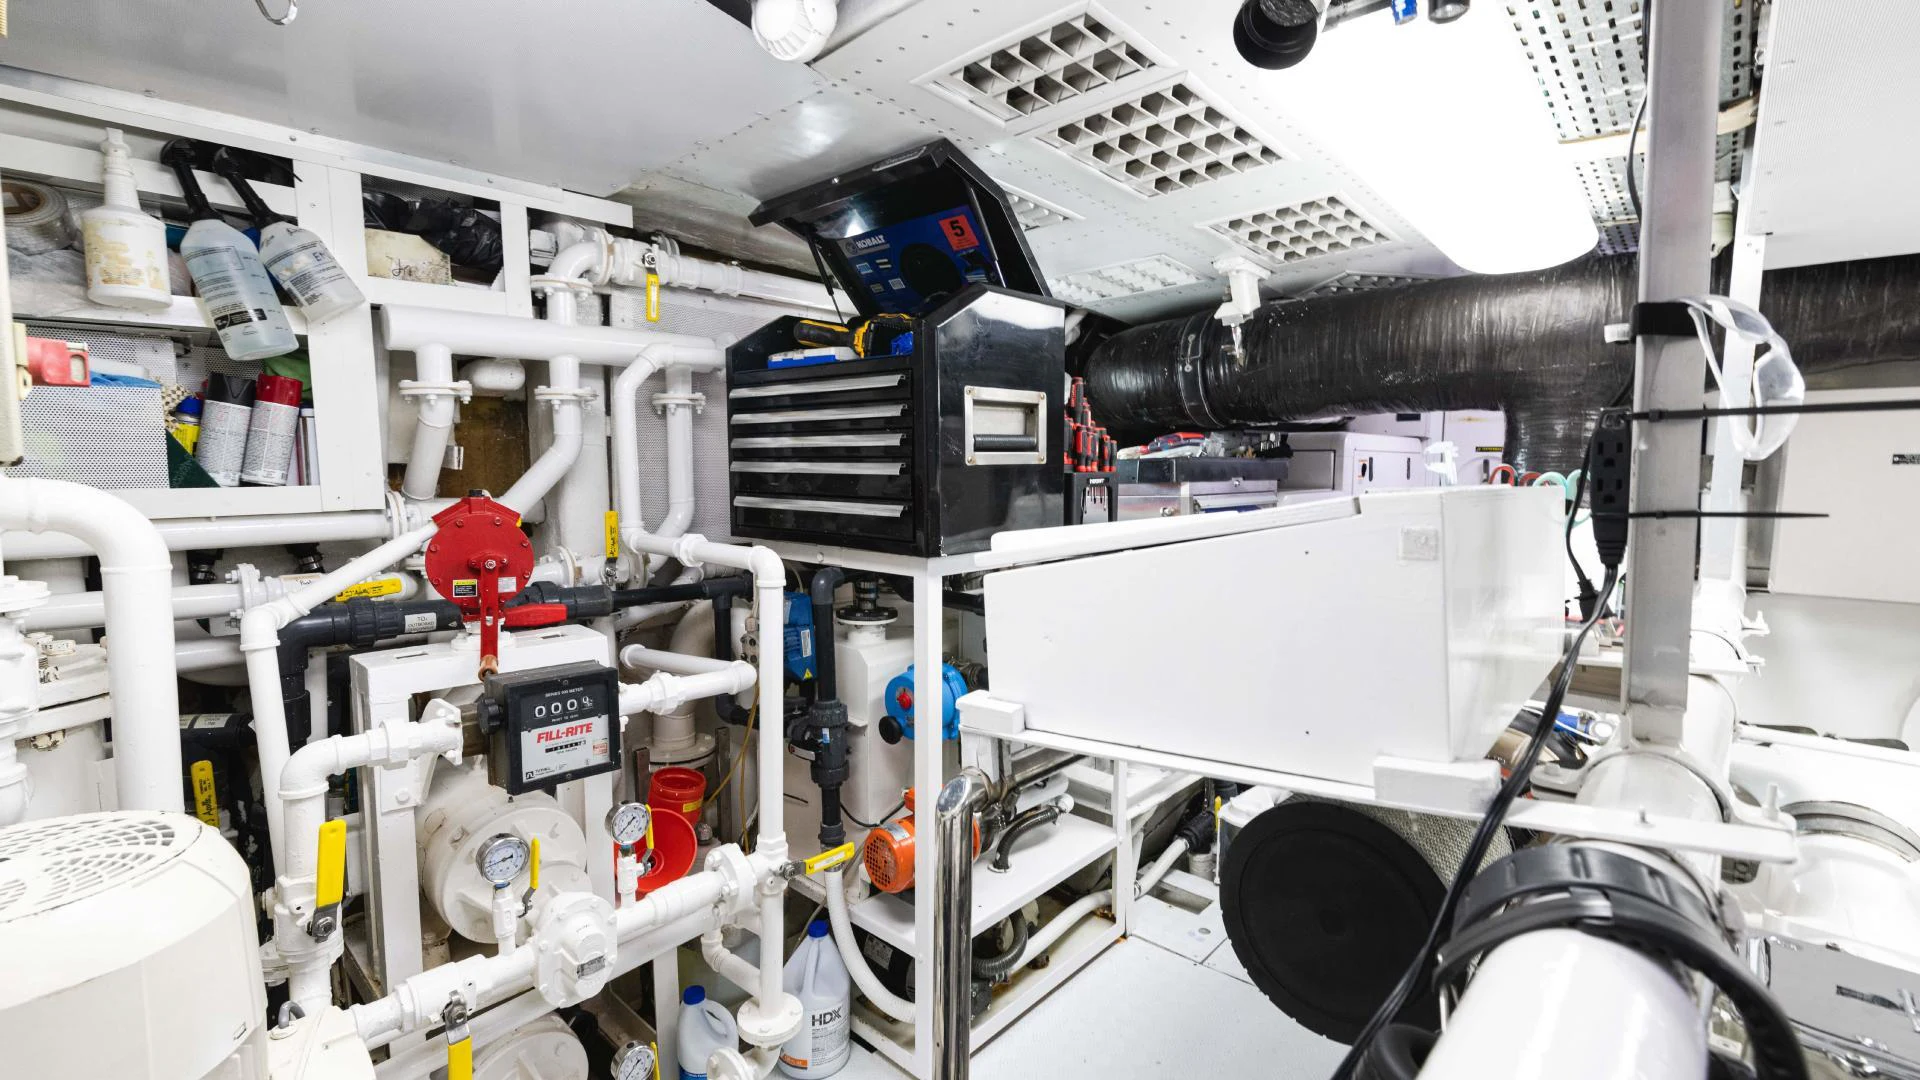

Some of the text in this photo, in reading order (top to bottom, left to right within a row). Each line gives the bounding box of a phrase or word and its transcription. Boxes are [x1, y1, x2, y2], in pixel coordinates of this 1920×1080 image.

[949, 220, 965, 237] 5
[856, 235, 885, 249] KOBALT
[537, 722, 592, 744] FILL-RITE
[812, 1007, 842, 1026] HDX
